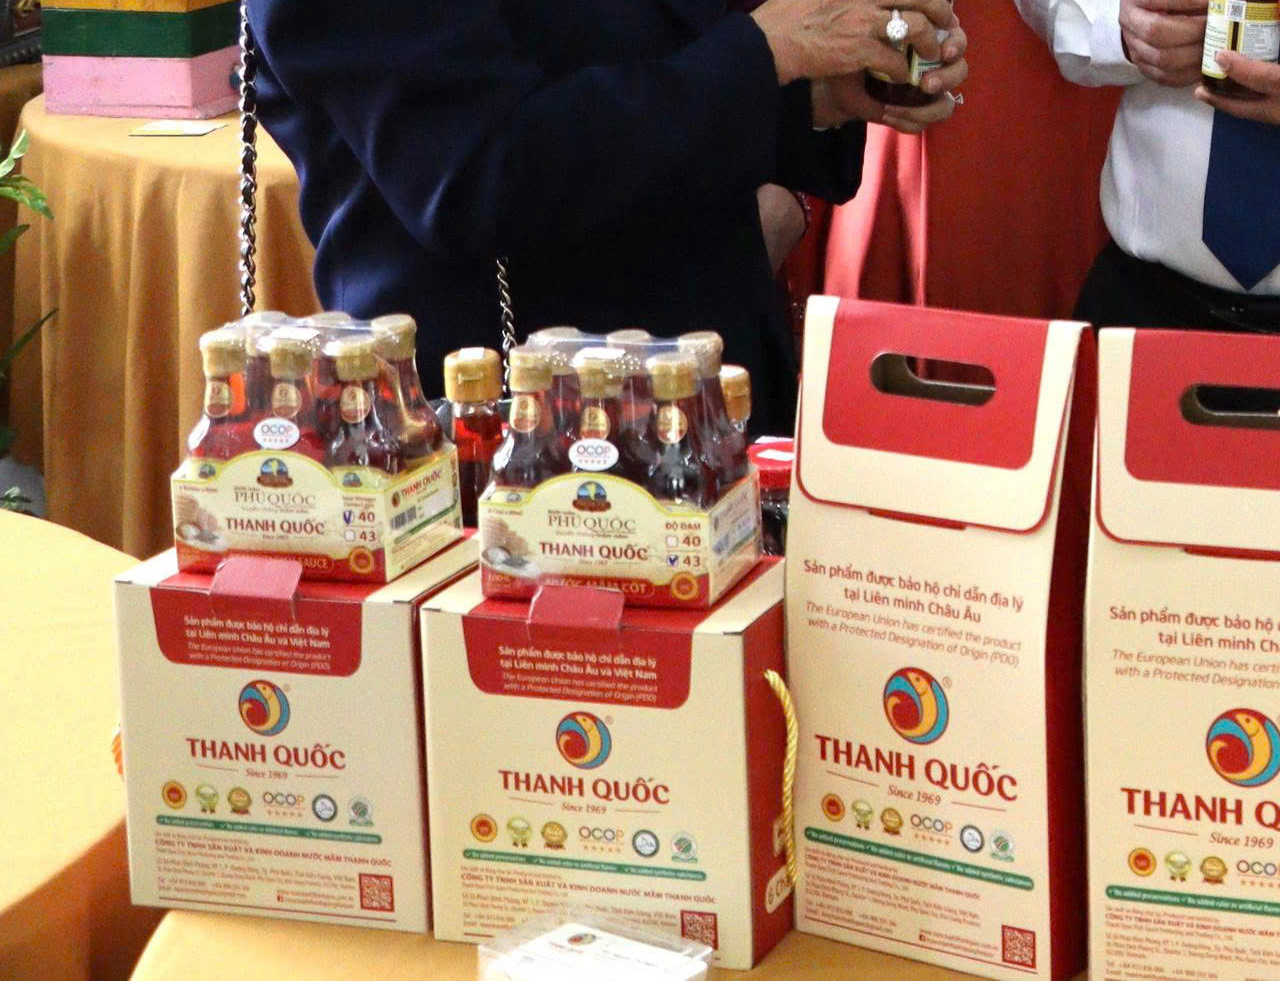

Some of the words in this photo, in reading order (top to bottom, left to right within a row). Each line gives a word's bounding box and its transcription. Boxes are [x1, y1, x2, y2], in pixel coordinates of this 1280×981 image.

[226, 518, 276, 532] THANH
[280, 518, 326, 535] QUỐC
[358, 512, 376, 523] 40
[359, 531, 376, 542] 43
[682, 536, 701, 546] 40
[539, 541, 594, 557] THANH
[599, 544, 648, 560] QUỐC
[683, 555, 701, 567] 43
[803, 559, 825, 574] Sản
[829, 563, 862, 581] phẩm
[898, 575, 921, 591] bảo
[924, 580, 940, 596] hộ
[943, 584, 960, 598] chỉ
[963, 585, 986, 603] dẫn
[990, 592, 1008, 607] địa
[1012, 596, 1023, 612] lý
[844, 587, 859, 601] tại
[863, 590, 889, 605] Liên
[893, 597, 924, 612] minh
[928, 601, 959, 619] Châu
[963, 607, 980, 623] Âu
[1109, 605, 1136, 620] Sản
[1140, 606, 1181, 624] phẩm
[1184, 612, 1219, 629] được
[1224, 614, 1251, 629] bảo
[1255, 617, 1273, 634] hộ
[1158, 631, 1177, 646] tại
[1182, 633, 1213, 647] Liên
[1218, 636, 1255, 650] minh
[1113, 649, 1133, 661] The
[1136, 651, 1190, 666] European
[1193, 656, 1226, 668] Union
[1228, 659, 1249, 671] has
[1114, 666, 1140, 676] with
[1142, 669, 1150, 678] a
[1152, 669, 1210, 683] Protected
[1211, 673, 1280, 688] Designation
[186, 738, 266, 763] THANH
[273, 743, 345, 769] QUỐC
[246, 768, 265, 778] Since
[269, 770, 287, 778] 1969
[814, 734, 914, 780] THANH
[924, 758, 1017, 801] QUỐC
[498, 770, 584, 796] THANH
[592, 777, 669, 804] QUỐC
[887, 784, 913, 799] Since
[916, 791, 940, 805] 1969
[262, 791, 304, 805] OCOP
[561, 802, 582, 811] Since
[586, 804, 606, 813] 1969
[1120, 787, 1242, 825] THANH
[910, 813, 952, 832] OCOP
[578, 826, 624, 841] OCOP
[1210, 832, 1240, 845] Since
[1244, 836, 1273, 848] 1969
